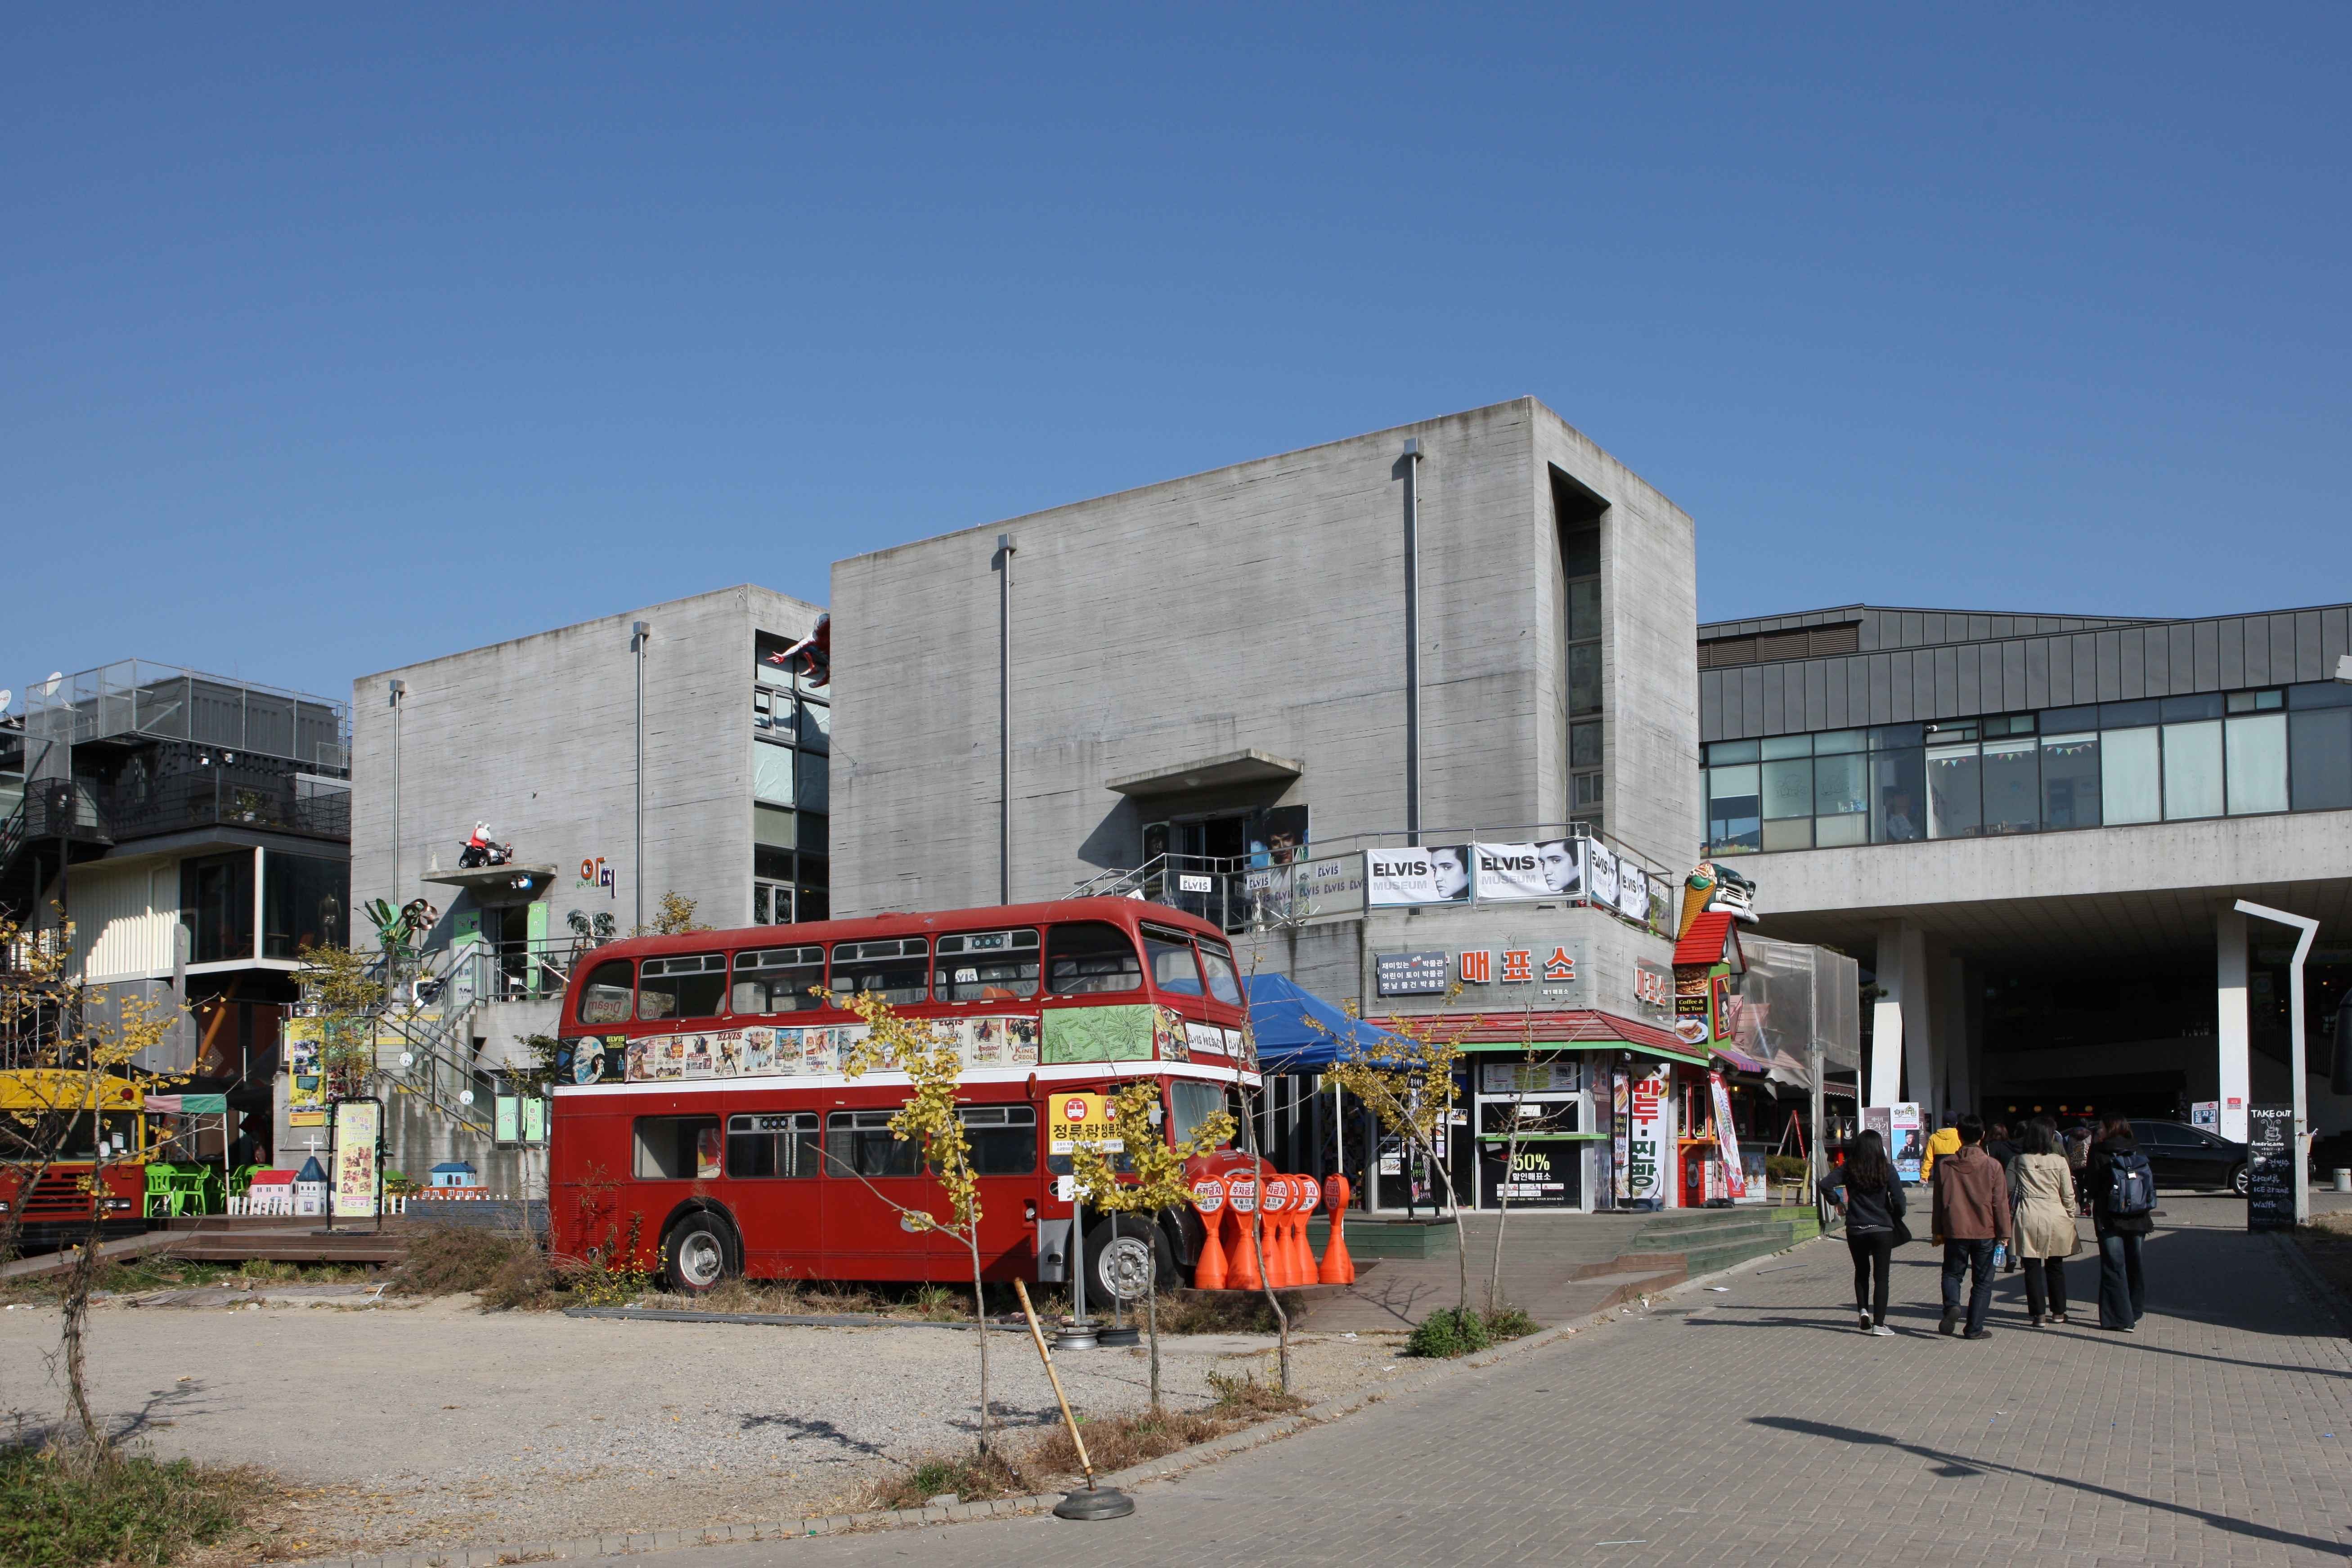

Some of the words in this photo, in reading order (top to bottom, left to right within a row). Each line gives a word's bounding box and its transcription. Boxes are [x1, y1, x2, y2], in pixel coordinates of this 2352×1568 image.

[1373, 861, 1427, 877] ELVIS
[1481, 856, 1535, 871] ELVIS
[1318, 865, 1338, 878] ELVIS
[1183, 880, 1207, 890] ELVIS
[1249, 877, 1268, 889] ELVIS
[1373, 880, 1427, 891] MUSEUM
[1482, 875, 1536, 885] MUSEUM
[1299, 885, 1320, 898] ELVIS
[1324, 882, 1345, 894] ELVIS
[1382, 961, 1409, 970] 재미있는
[1422, 959, 1443, 968] 박물관
[1461, 946, 1575, 982] 매표소
[1422, 970, 1444, 978] 박물관
[1420, 980, 1444, 988] 박물관
[1634, 967, 1666, 1006] 매표소
[717, 1032, 742, 1041] ELVIS
[1188, 1033, 1202, 1045] ELVIS
[1203, 1036, 1222, 1049] PRESLEY
[2250, 1110, 2275, 1118] TAKE
[1101, 1123, 1122, 1138] 정류장
[1867, 1122, 1889, 1130] 도자기
[1513, 1153, 1551, 1171] 50%
[1512, 1172, 1551, 1181] 할인매표소
[1267, 1185, 1286, 1196] 차금지
[2253, 1201, 2276, 1209] Waffle
